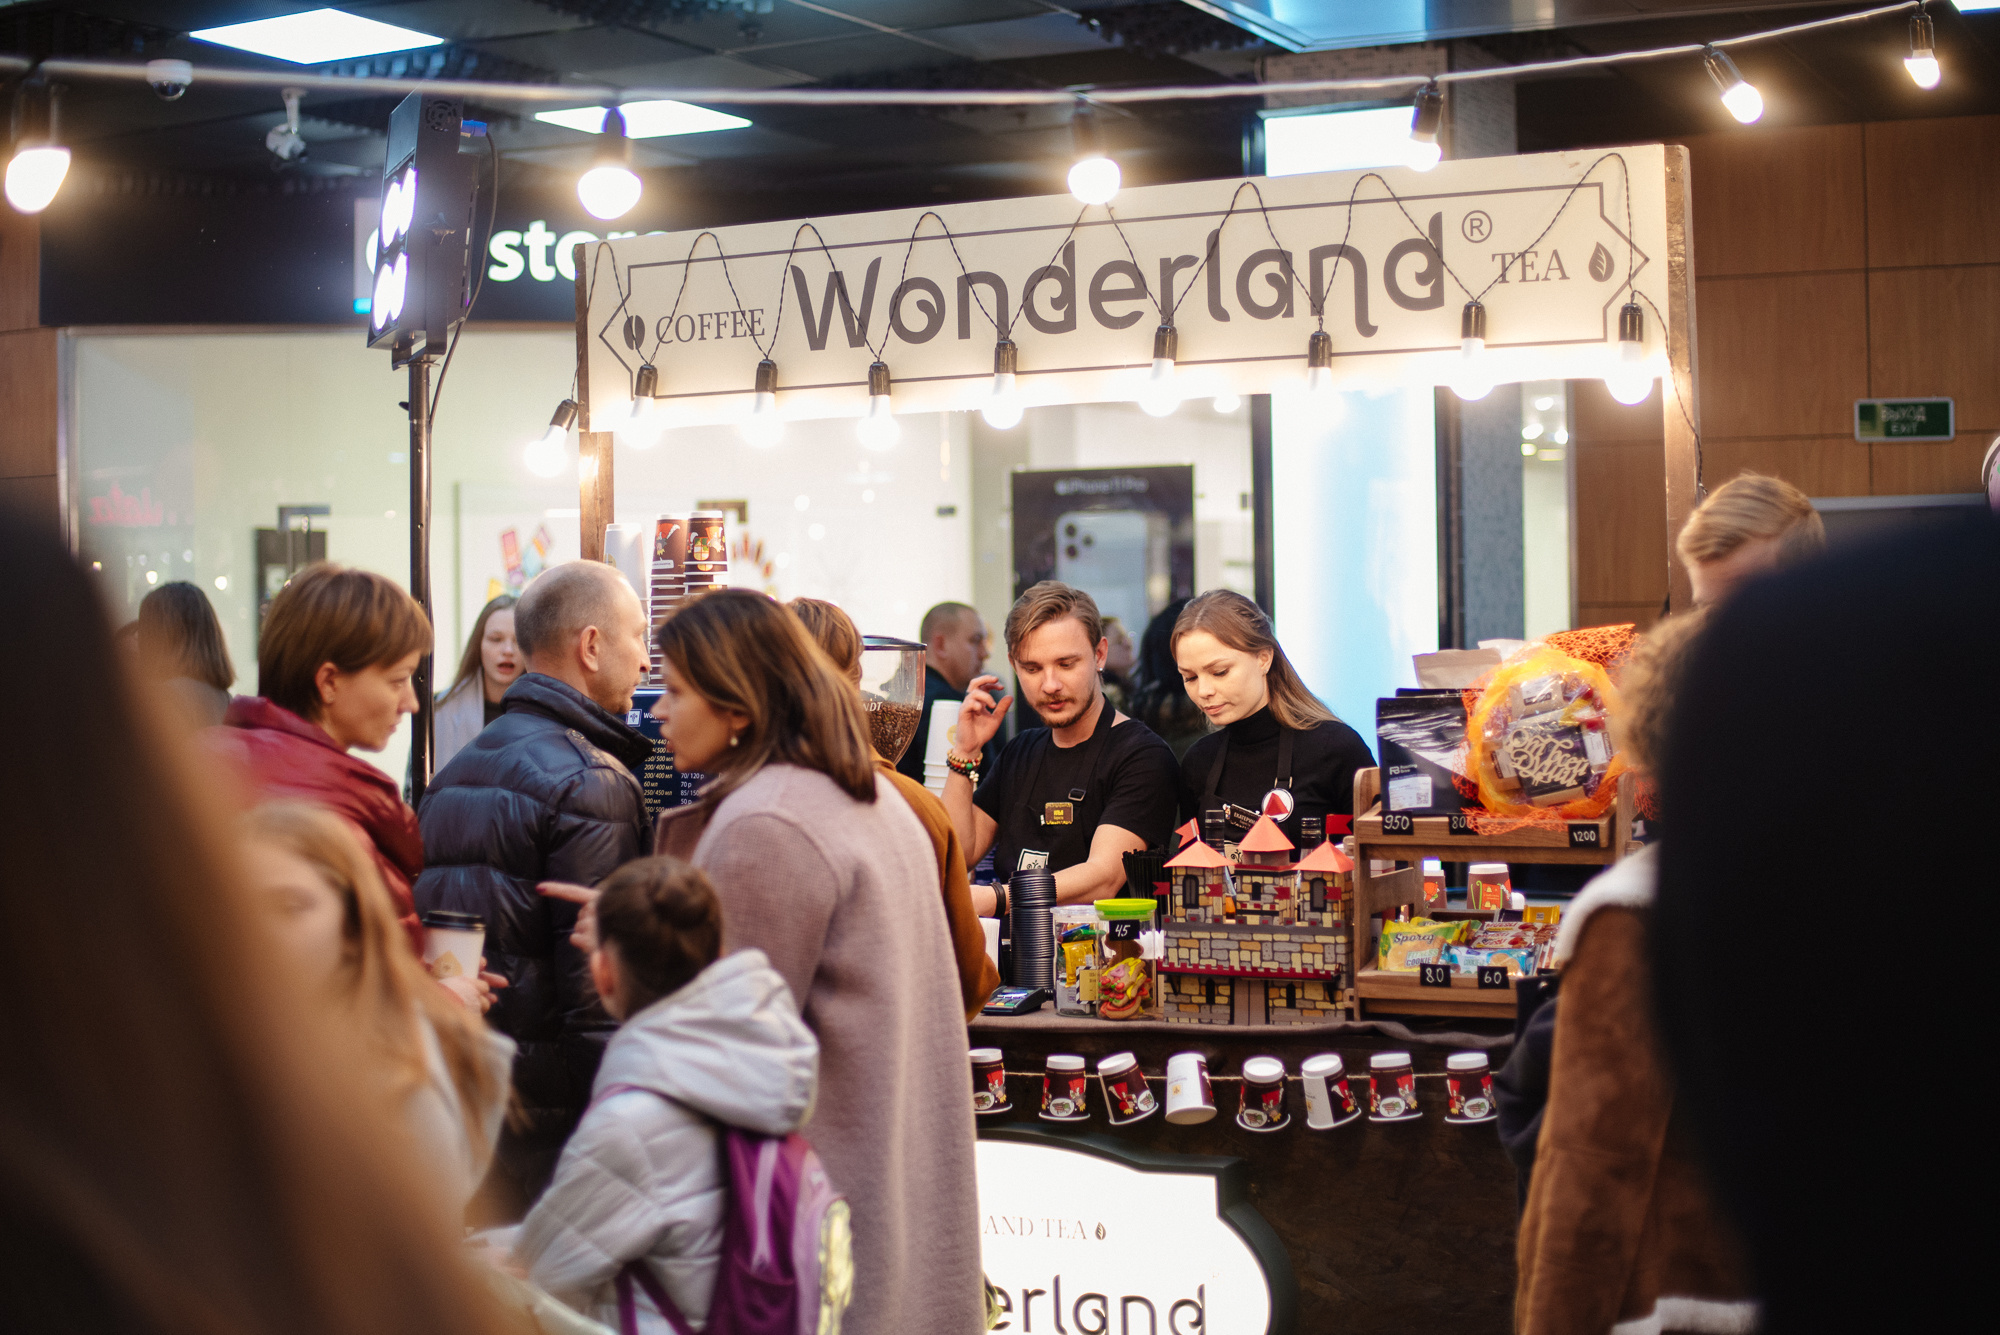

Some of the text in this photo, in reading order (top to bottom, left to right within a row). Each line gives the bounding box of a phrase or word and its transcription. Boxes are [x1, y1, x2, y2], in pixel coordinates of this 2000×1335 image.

[488, 220, 668, 283] sto
[1491, 249, 1571, 284] TEA
[790, 210, 1445, 352] Wonderland
[656, 308, 765, 344] COFFEE
[1384, 814, 1410, 830] 950
[1573, 830, 1596, 842] 1200
[1115, 924, 1131, 937] 45
[1406, 956, 1431, 967] COOKIE
[1426, 968, 1444, 983] 80
[1484, 971, 1502, 984] 60
[984, 1215, 1088, 1240] AND TEA
